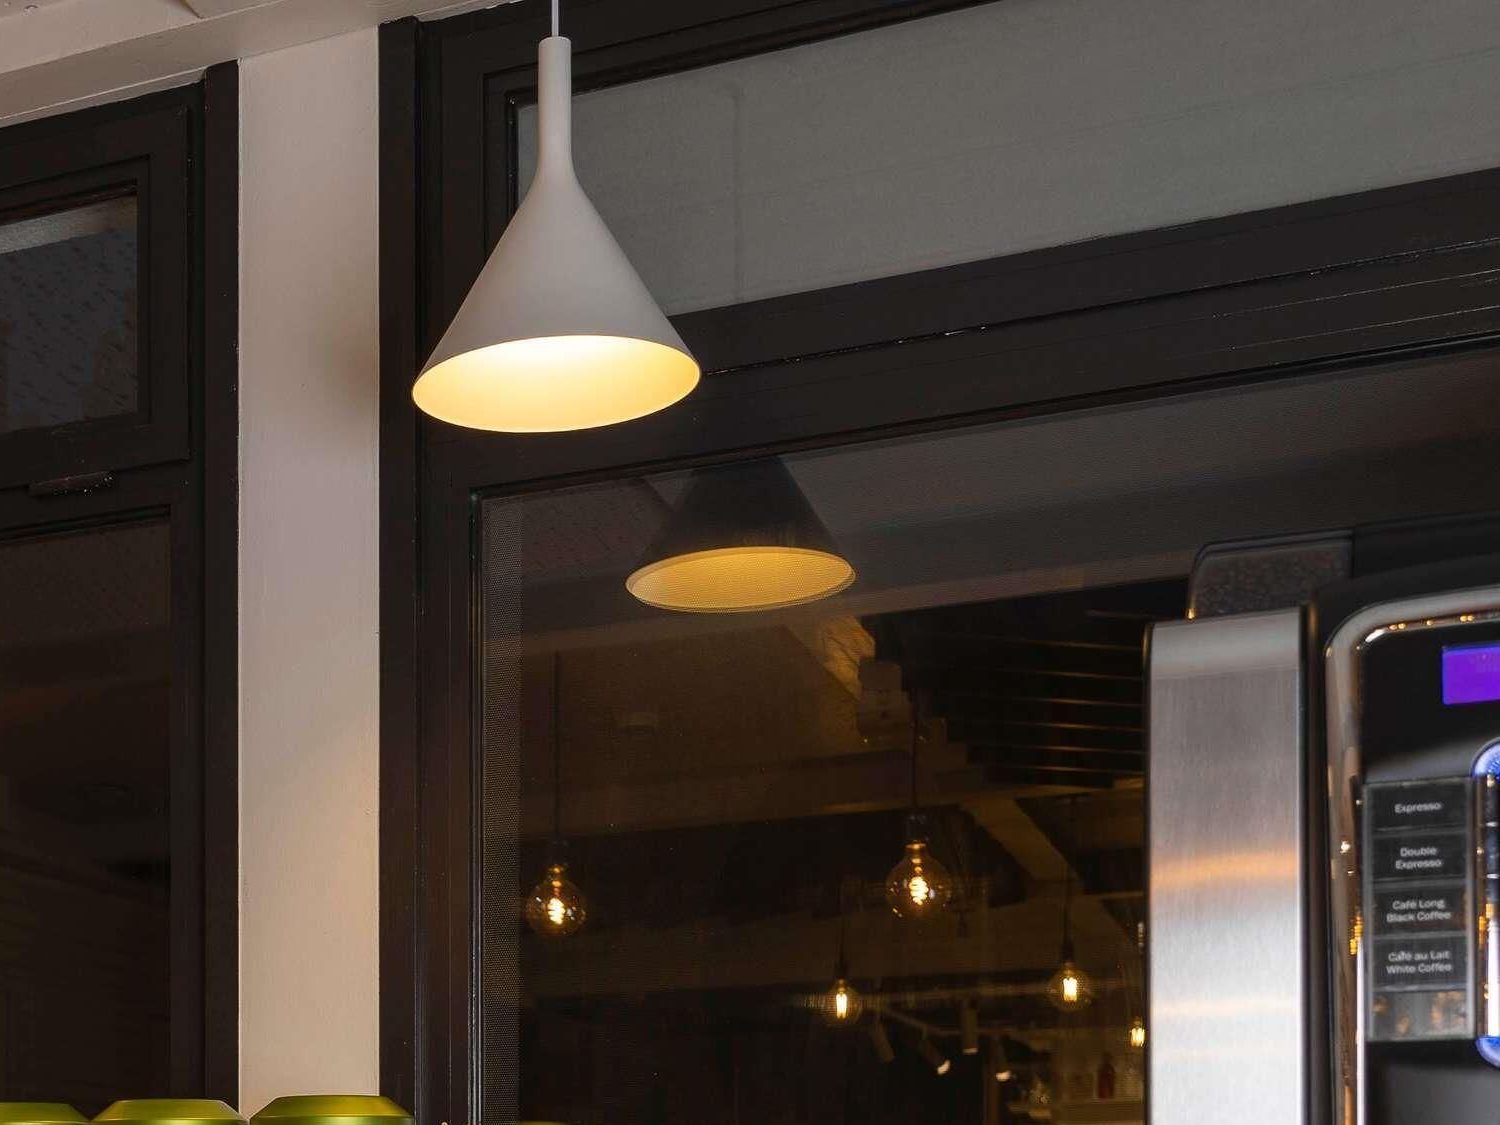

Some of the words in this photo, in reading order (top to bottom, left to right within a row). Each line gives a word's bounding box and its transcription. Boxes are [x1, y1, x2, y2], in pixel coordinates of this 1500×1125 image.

[1394, 802, 1442, 814] Expresso
[1400, 847, 1437, 857] Double
[1395, 859, 1442, 870] Expresso
[1392, 900, 1417, 910] Café
[1418, 899, 1445, 910] Long
[1386, 912, 1415, 923] Black
[1417, 911, 1452, 921] Coffee
[1388, 951, 1412, 962] Café
[1414, 952, 1429, 961] au
[1429, 950, 1450, 960] Lait
[1386, 964, 1416, 974] White
[1418, 963, 1452, 973] Coffee
